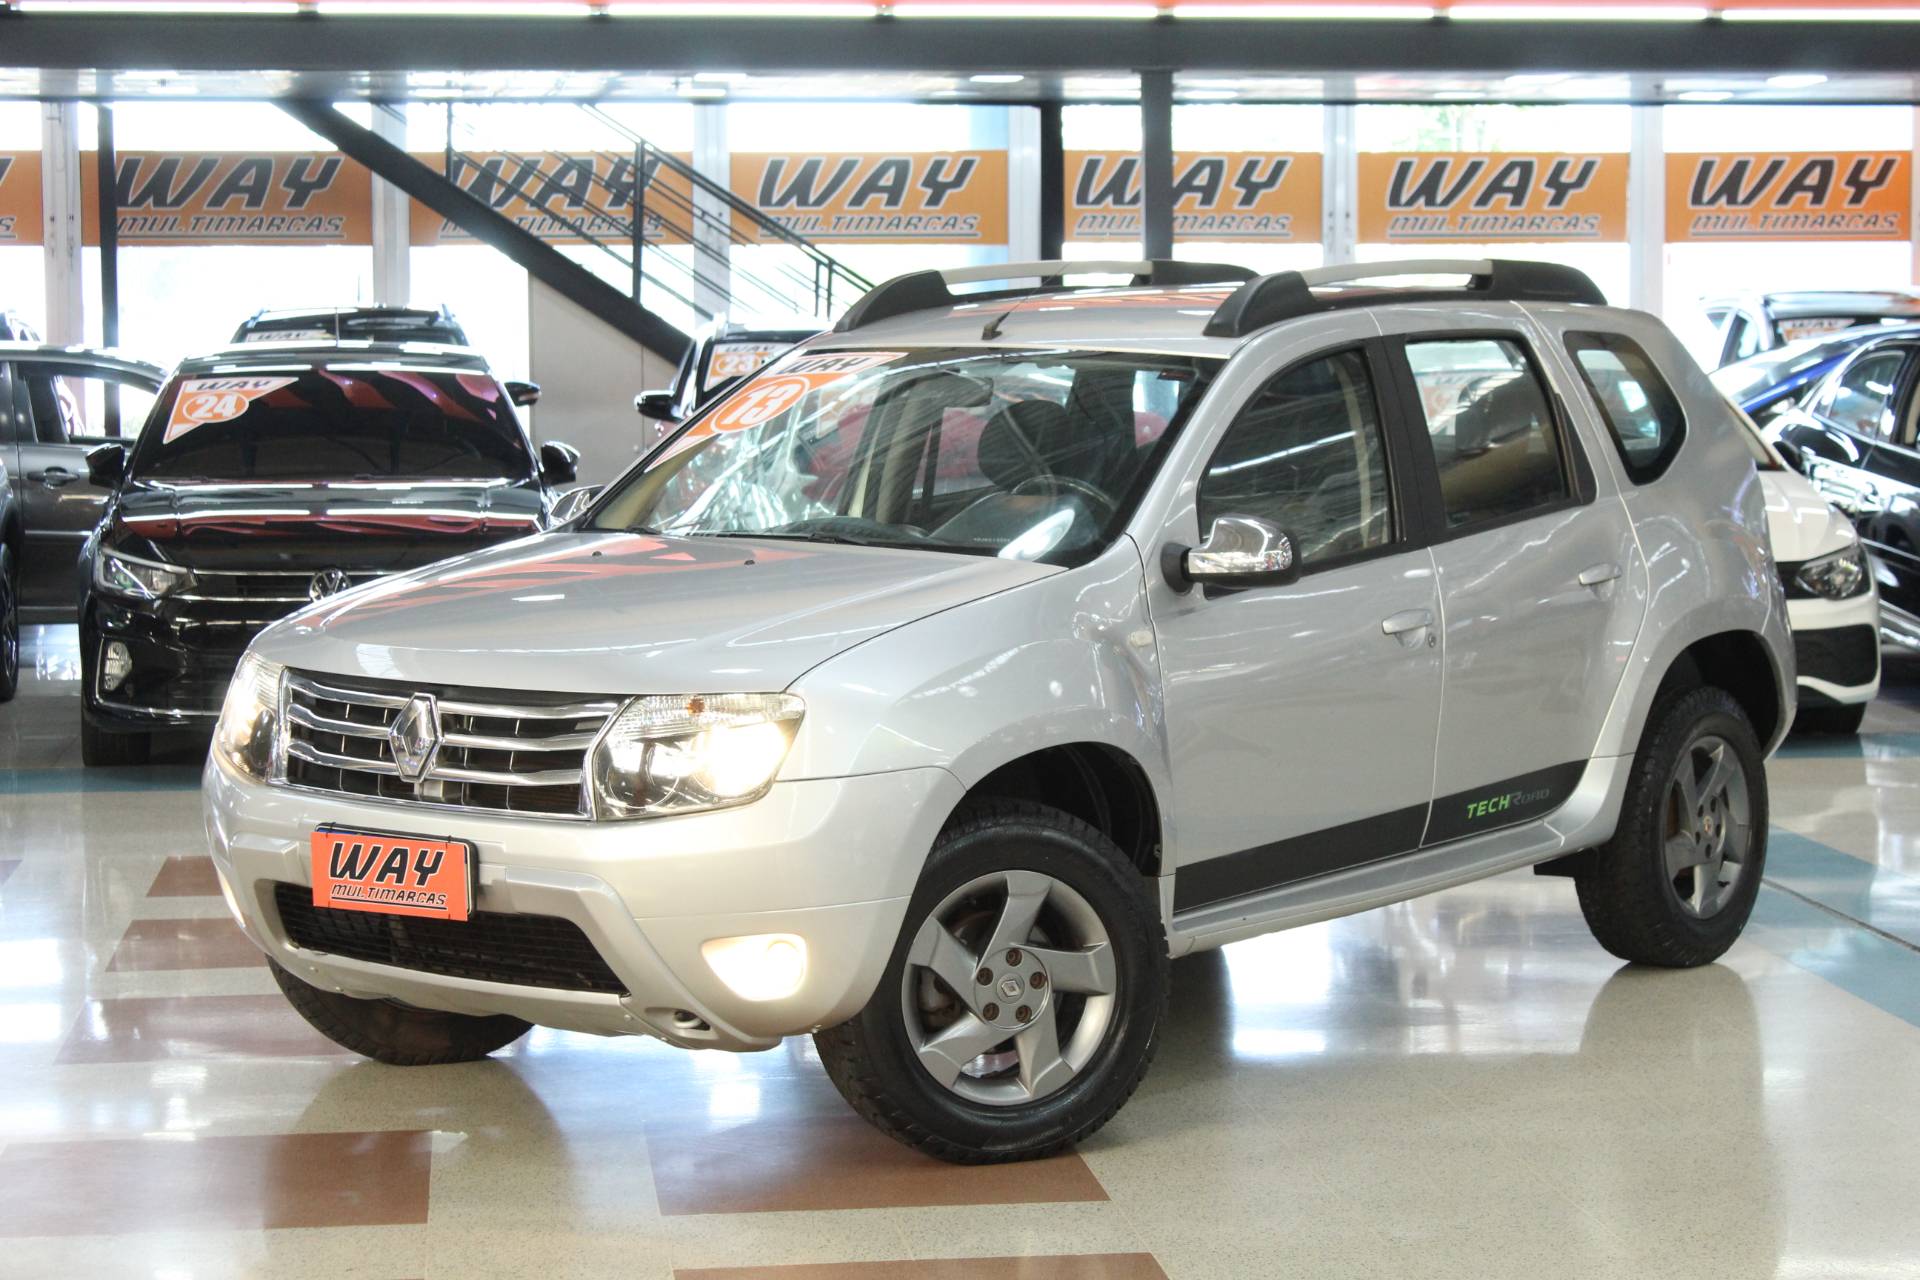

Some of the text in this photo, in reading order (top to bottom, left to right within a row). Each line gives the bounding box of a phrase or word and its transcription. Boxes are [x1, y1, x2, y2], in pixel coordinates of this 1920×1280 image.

[115, 157, 345, 211] WAY
[758, 156, 981, 210] WAY
[1074, 156, 1293, 209] WAY
[1386, 157, 1600, 210] WAY
[1689, 156, 1901, 208] WAY
[116, 215, 345, 233] MULTIMARCAS
[760, 215, 980, 231] MULTIMARCAS
[1077, 214, 1291, 231] MULMARCAS
[1390, 215, 1599, 231] MULTIMARCAS
[1691, 213, 1900, 230] MULTIMARCAS
[191, 394, 238, 418] 24
[721, 383, 802, 426] 13
[328, 841, 446, 888] WAY
[331, 884, 447, 906] MULTIMARCAS
